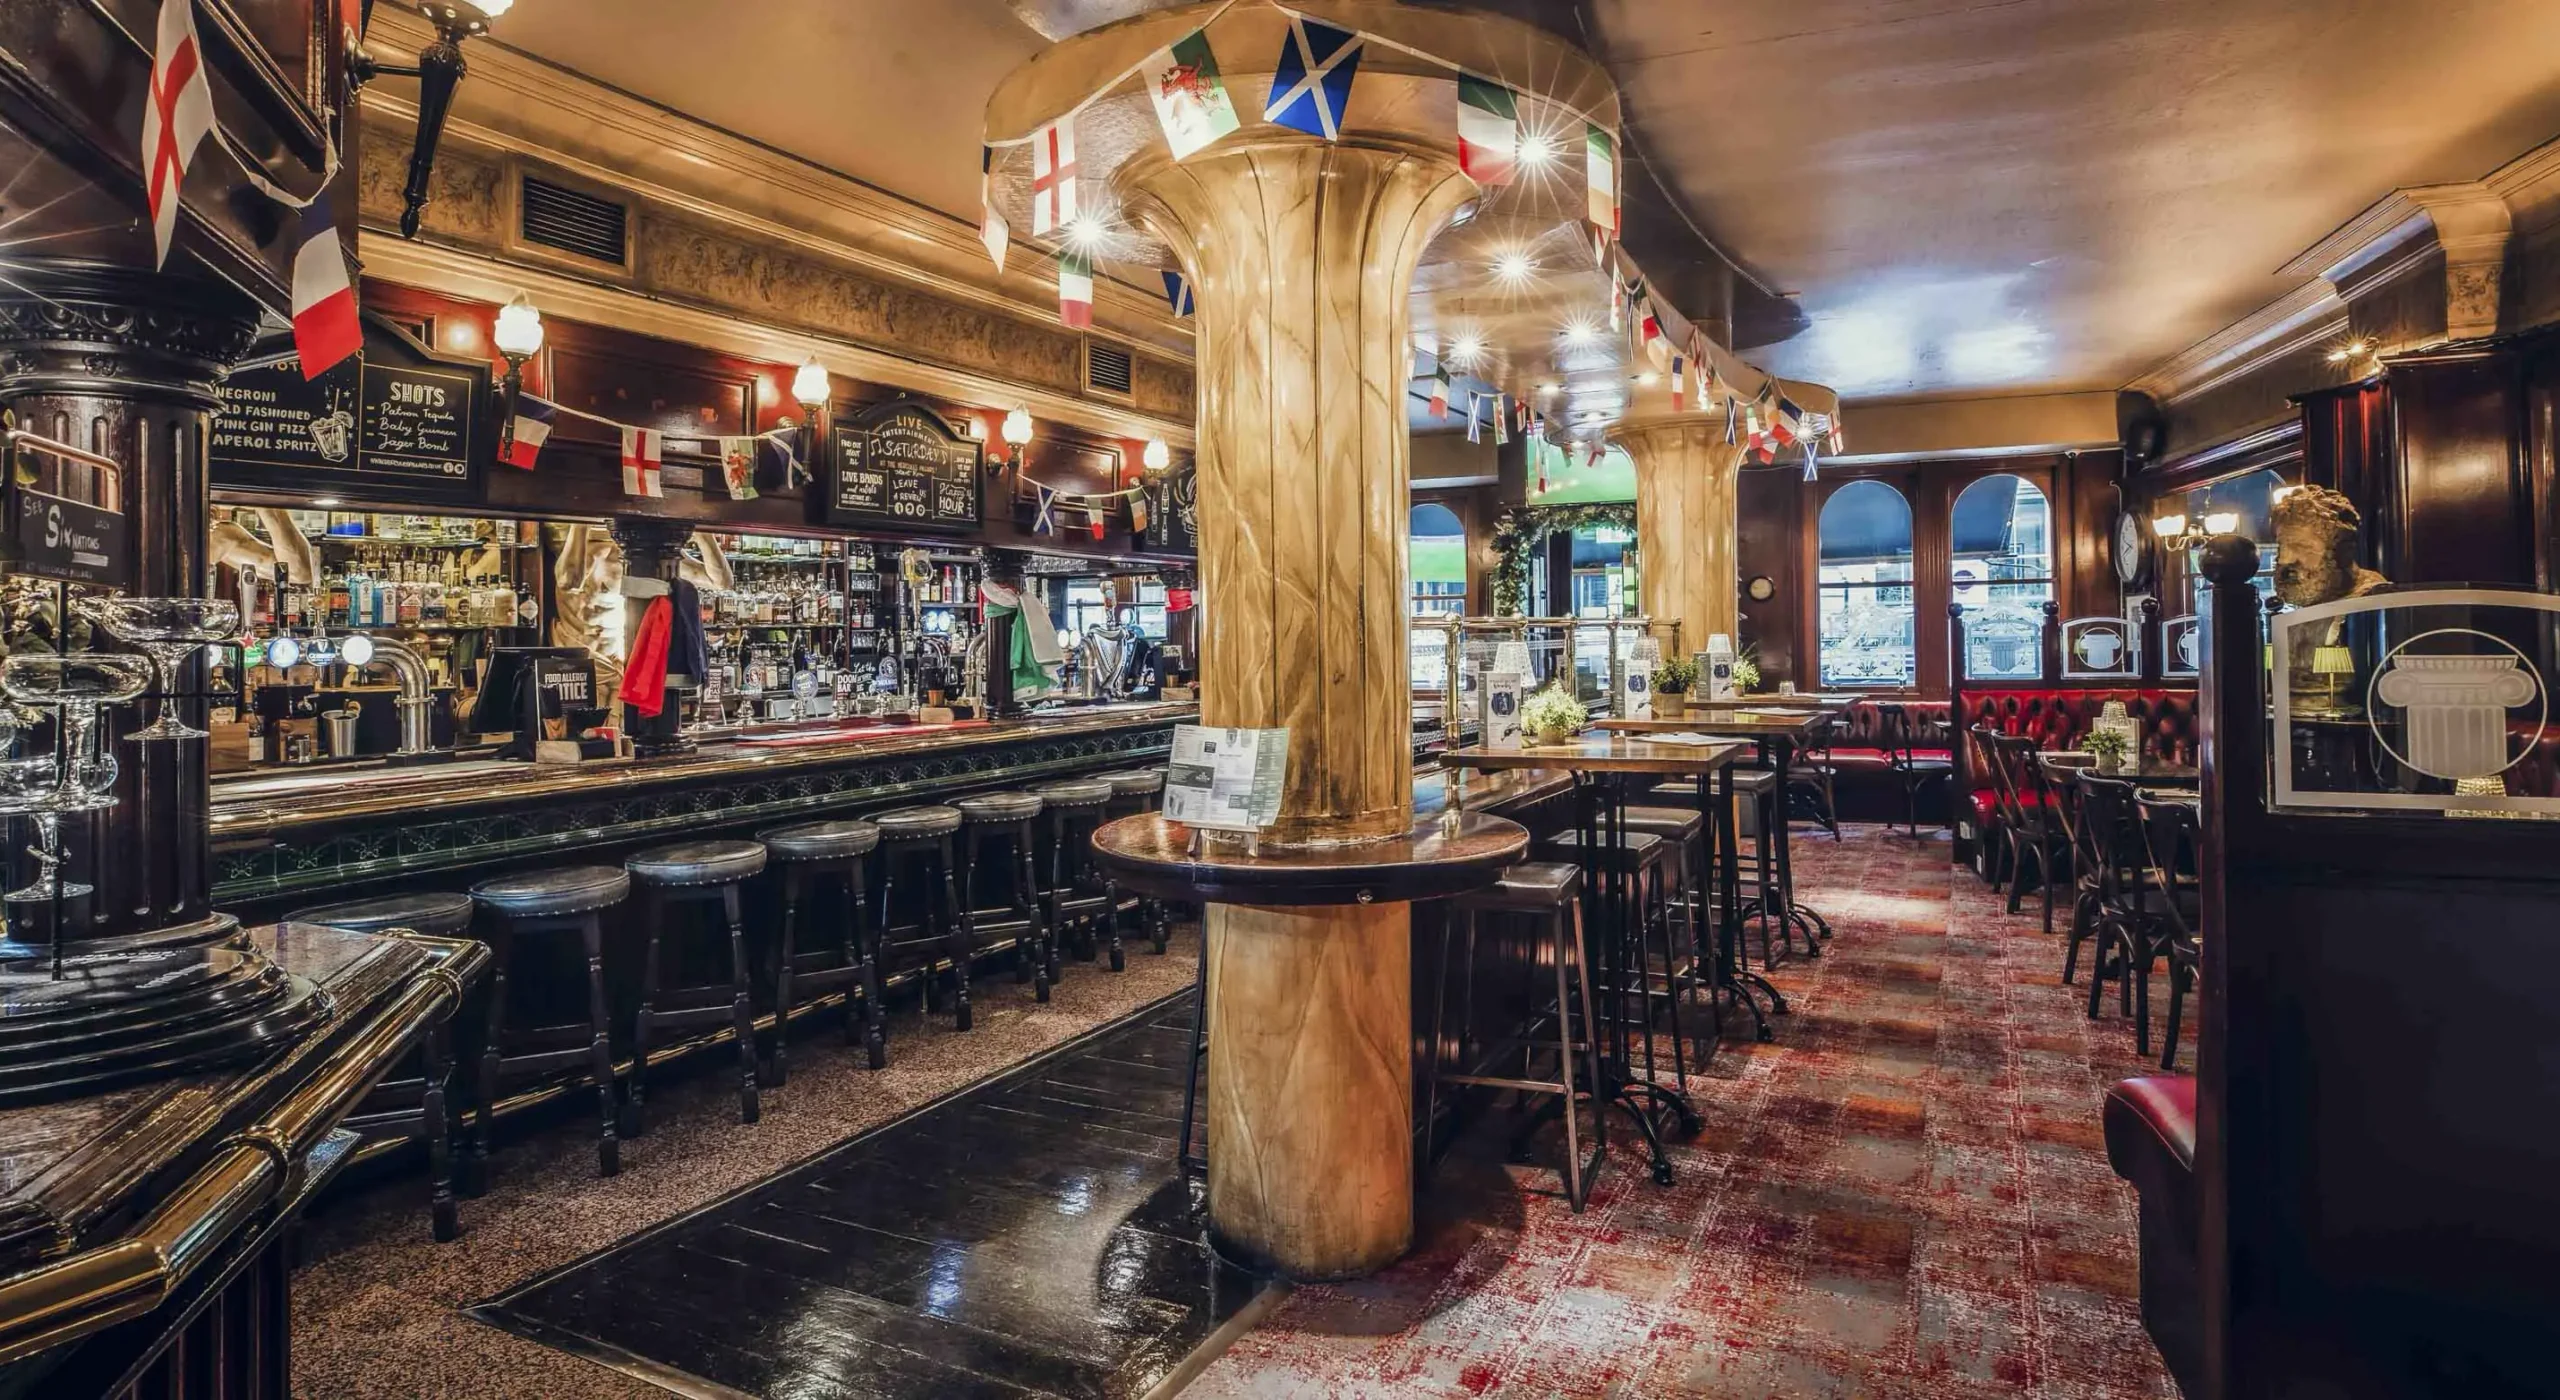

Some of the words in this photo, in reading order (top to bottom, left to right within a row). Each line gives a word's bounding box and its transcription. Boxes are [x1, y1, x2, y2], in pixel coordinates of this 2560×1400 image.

[215, 386, 277, 402] NEGRONI
[390, 382, 445, 407] SHOTS
[224, 404, 241, 415] LD
[245, 406, 311, 420] FASHIONED
[381, 402, 419, 418] Patron
[214, 418, 247, 431] PINK
[250, 421, 274, 432] GIN
[278, 423, 307, 435] FIZZ
[379, 417, 412, 436] Baby
[896, 415, 922, 430] LIVE
[212, 434, 272, 449] APEROL
[275, 439, 318, 452] SPRITZ
[417, 437, 450, 451] Bomb
[882, 428, 935, 446] ENTERTAINMENT
[883, 440, 940, 462] SATURDAY
[842, 471, 858, 483] LIVE
[859, 473, 883, 485] BANDS
[893, 480, 919, 489] LEAVE
[940, 496, 965, 514] HOUR
[545, 673, 561, 683] FOOD
[562, 672, 587, 682] ALLERGY
[559, 682, 588, 700] TICE
